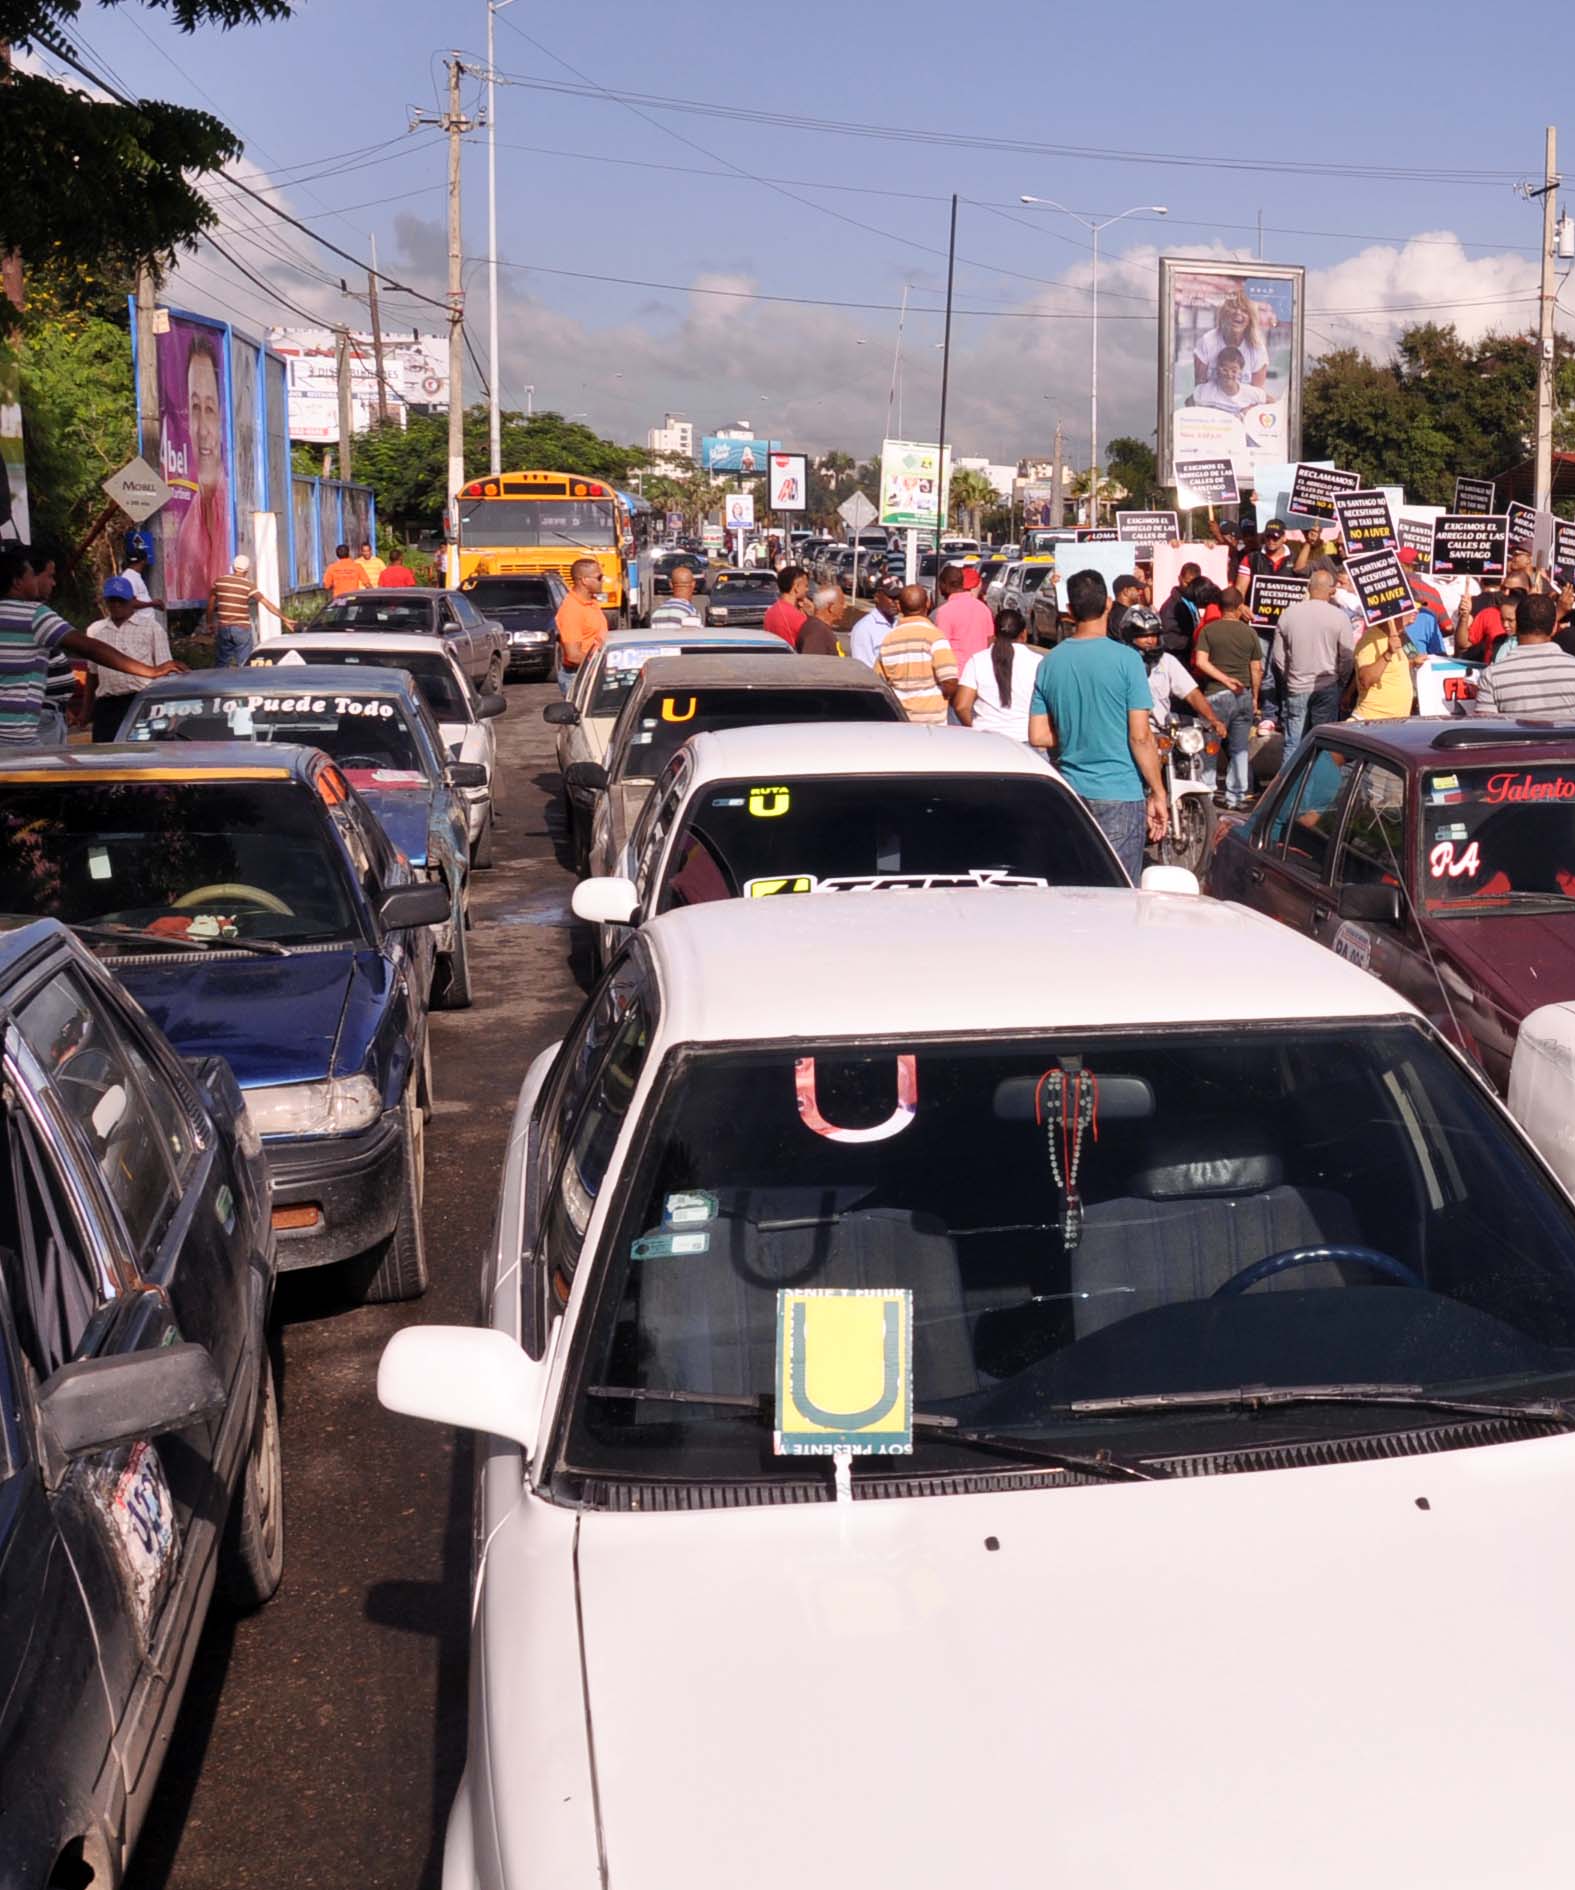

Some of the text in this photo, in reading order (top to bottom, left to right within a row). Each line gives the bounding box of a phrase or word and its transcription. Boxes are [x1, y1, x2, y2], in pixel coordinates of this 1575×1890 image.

[1184, 464, 1216, 472] EXIGIMOS
[1180, 471, 1208, 479] ARREGLO
[1337, 498, 1386, 508] EN SANTIAGO NO
[1343, 508, 1385, 517] NECESITAMOS
[1160, 517, 1168, 525] EL
[1348, 519, 1358, 527] UN
[1358, 518, 1373, 526] TAXI
[1400, 524, 1409, 532] EN
[1444, 523, 1497, 531] EXIGIMOS EL
[1092, 532, 1116, 540] LOMA
[1350, 527, 1391, 539] NO A UVER
[1436, 532, 1474, 540] ARREGLO
[1475, 532, 1488, 540] DE
[1489, 532, 1505, 540] LAS
[1447, 541, 1491, 549] CALLES DE
[1449, 551, 1491, 559] SANTIAGO
[1351, 556, 1396, 576] EN SANTIAGO NO
[1358, 567, 1398, 585] NECESITAMOS
[1256, 581, 1265, 589] EN
[1266, 583, 1301, 592] SANTIAGO
[1364, 577, 1400, 594] UN TAXI MAS
[1367, 587, 1405, 606] NO A UVER
[1272, 599, 1288, 607] TAXI
[1258, 606, 1272, 614] NO
[149, 696, 394, 719] Dios lo Puede Todo
[661, 697, 697, 722] U
[750, 786, 790, 795] RUTA
[749, 794, 790, 818] U
[795, 1054, 917, 1144] U
[791, 1301, 900, 1431] U
[793, 1444, 873, 1456] PRESENTE
[879, 1444, 913, 1455] SOY
